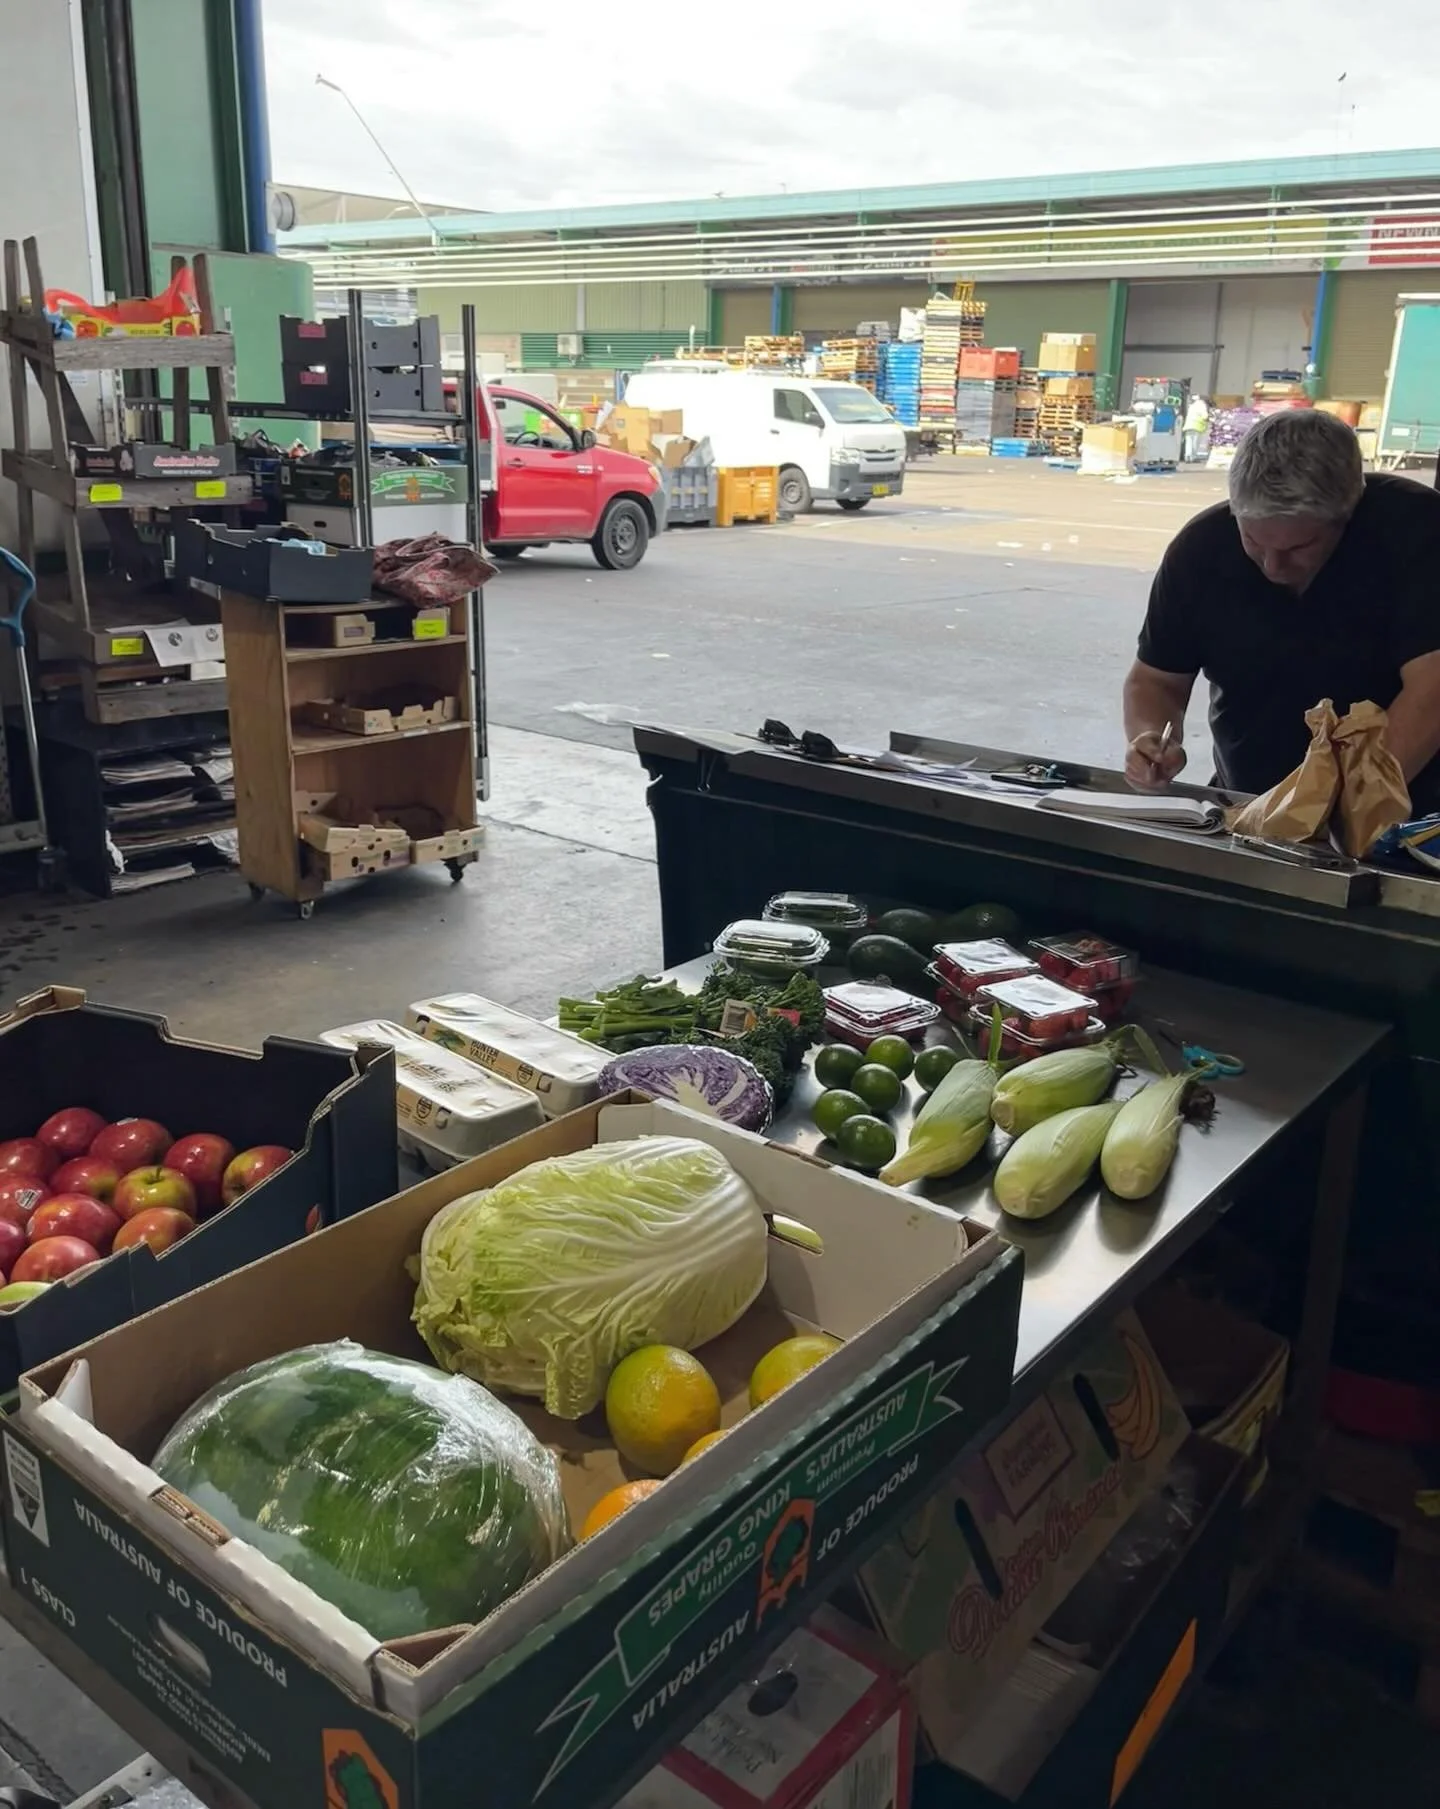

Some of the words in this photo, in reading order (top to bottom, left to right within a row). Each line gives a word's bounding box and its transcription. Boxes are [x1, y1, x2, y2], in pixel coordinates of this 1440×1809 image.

[470, 1047, 496, 1065] VALLEY
[471, 1040, 498, 1056] HUNTER
[805, 1390, 907, 1482] AUSTRALIA'S
[816, 1441, 874, 1493] Premium
[843, 1454, 920, 1534] PRODUCE
[739, 1480, 791, 1539] KING
[73, 1498, 162, 1584] AUSTRALIA
[698, 1540, 757, 1600] Quality
[816, 1527, 842, 1561] OF
[20, 1567, 26, 1584] 1
[32, 1578, 76, 1627] CLASS
[167, 1579, 191, 1608] OF
[647, 1538, 734, 1626] GRAPES
[195, 1600, 289, 1687] PRODUCE
[632, 1612, 749, 1731] AUSTRALIA
